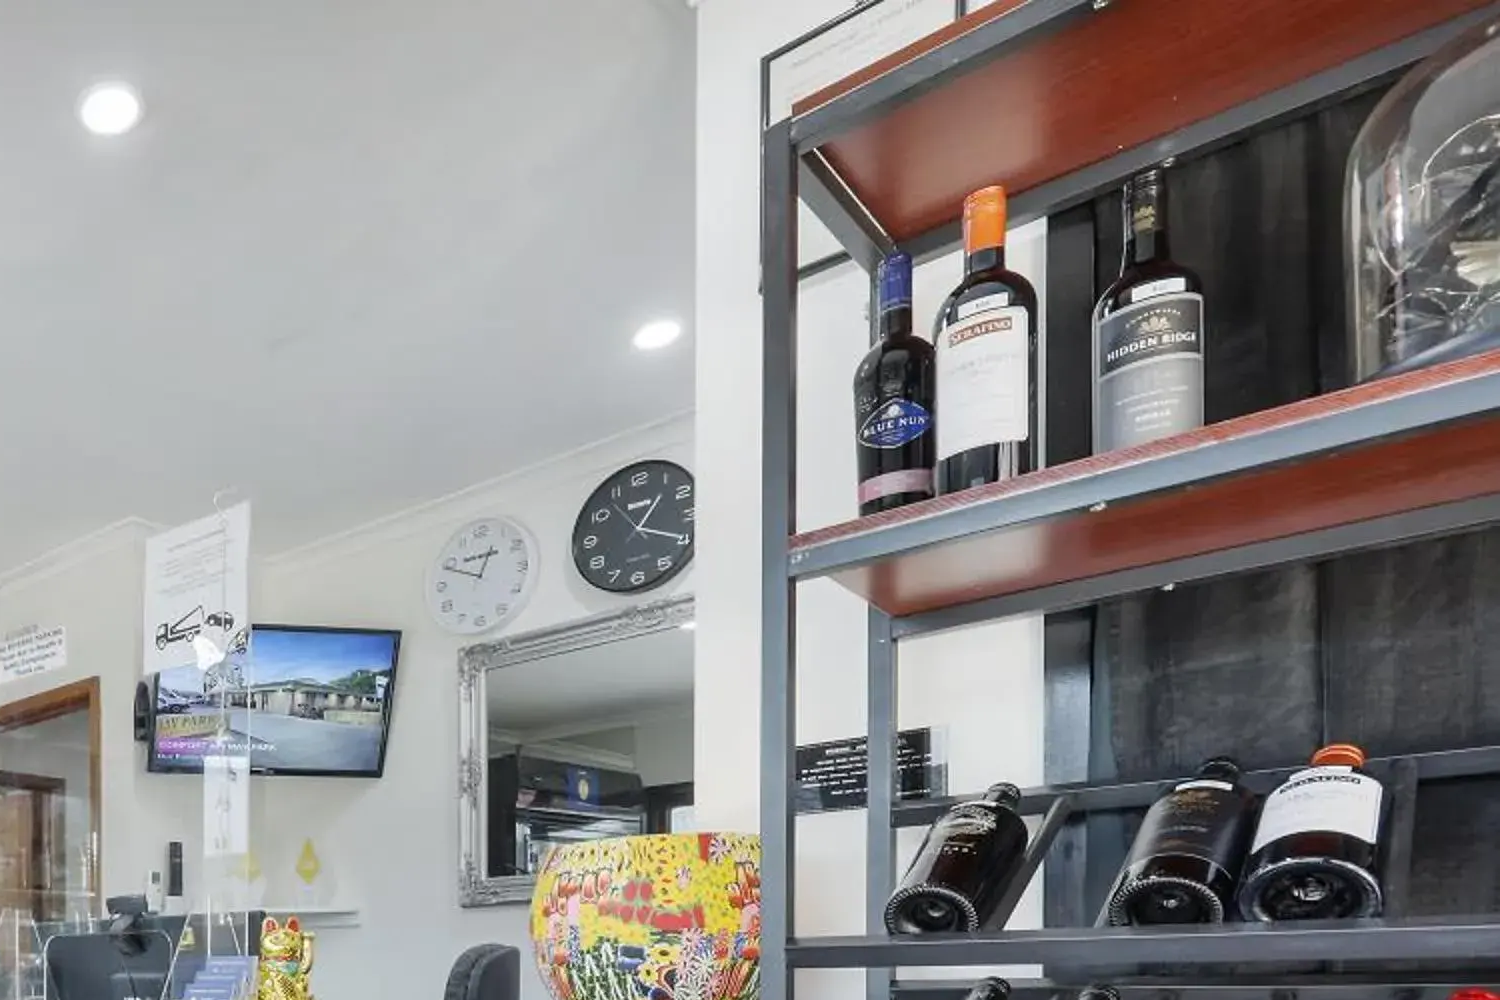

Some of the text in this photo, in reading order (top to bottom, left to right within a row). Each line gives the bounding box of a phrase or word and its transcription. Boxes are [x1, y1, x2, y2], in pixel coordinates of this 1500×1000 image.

[1107, 335, 1158, 362] HIDDEN
[631, 471, 649, 487] 12
[662, 471, 669, 485] 1
[611, 485, 621, 500] 11
[675, 484, 691, 500] 2
[591, 508, 611, 524] 10
[583, 535, 598, 549] 9
[676, 533, 691, 545] 4
[589, 555, 605, 569] 8
[657, 555, 672, 571] 5
[607, 569, 621, 583] 7
[630, 571, 645, 585] 6
